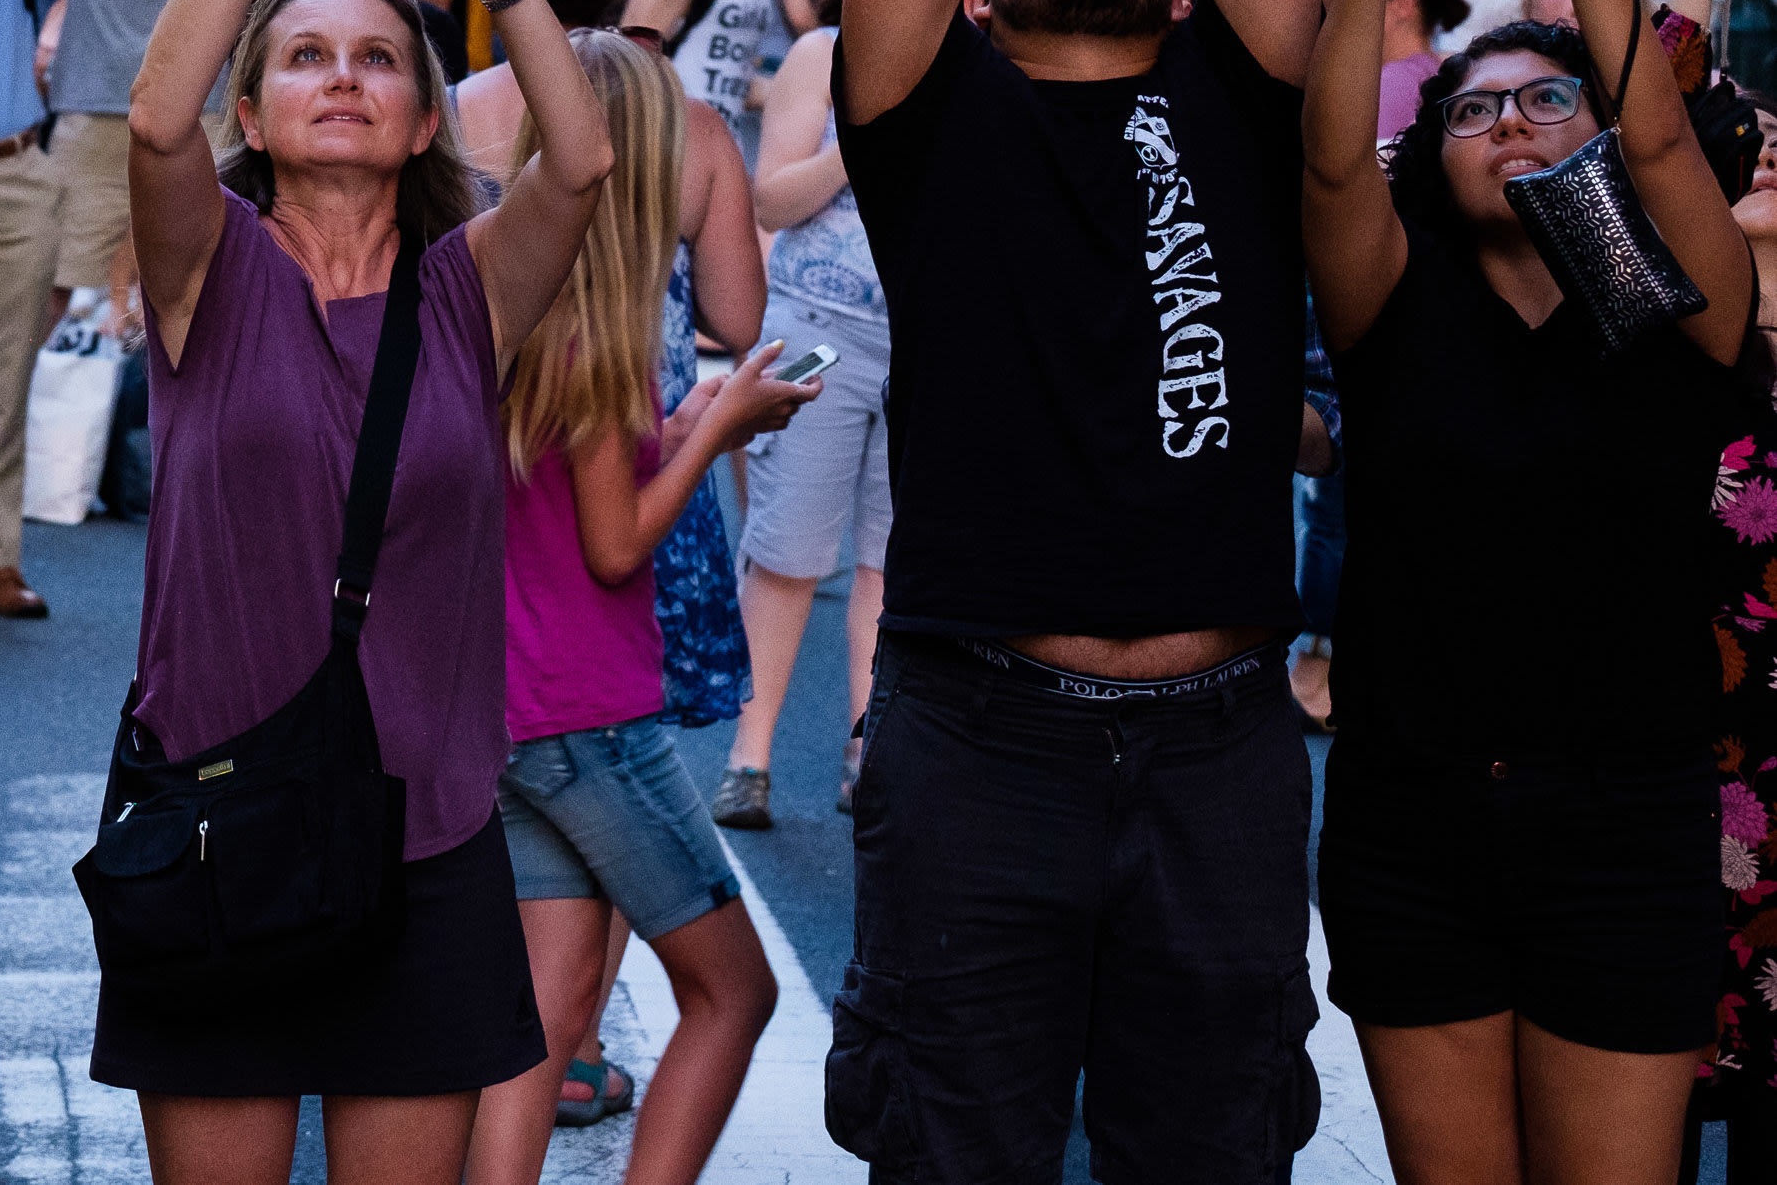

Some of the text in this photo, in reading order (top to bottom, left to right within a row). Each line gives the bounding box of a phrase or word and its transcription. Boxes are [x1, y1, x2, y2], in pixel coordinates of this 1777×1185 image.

[1145, 176, 1229, 458] SAVAGES
[1058, 677, 1121, 699] POLO
[1202, 656, 1262, 688] LAUREN
